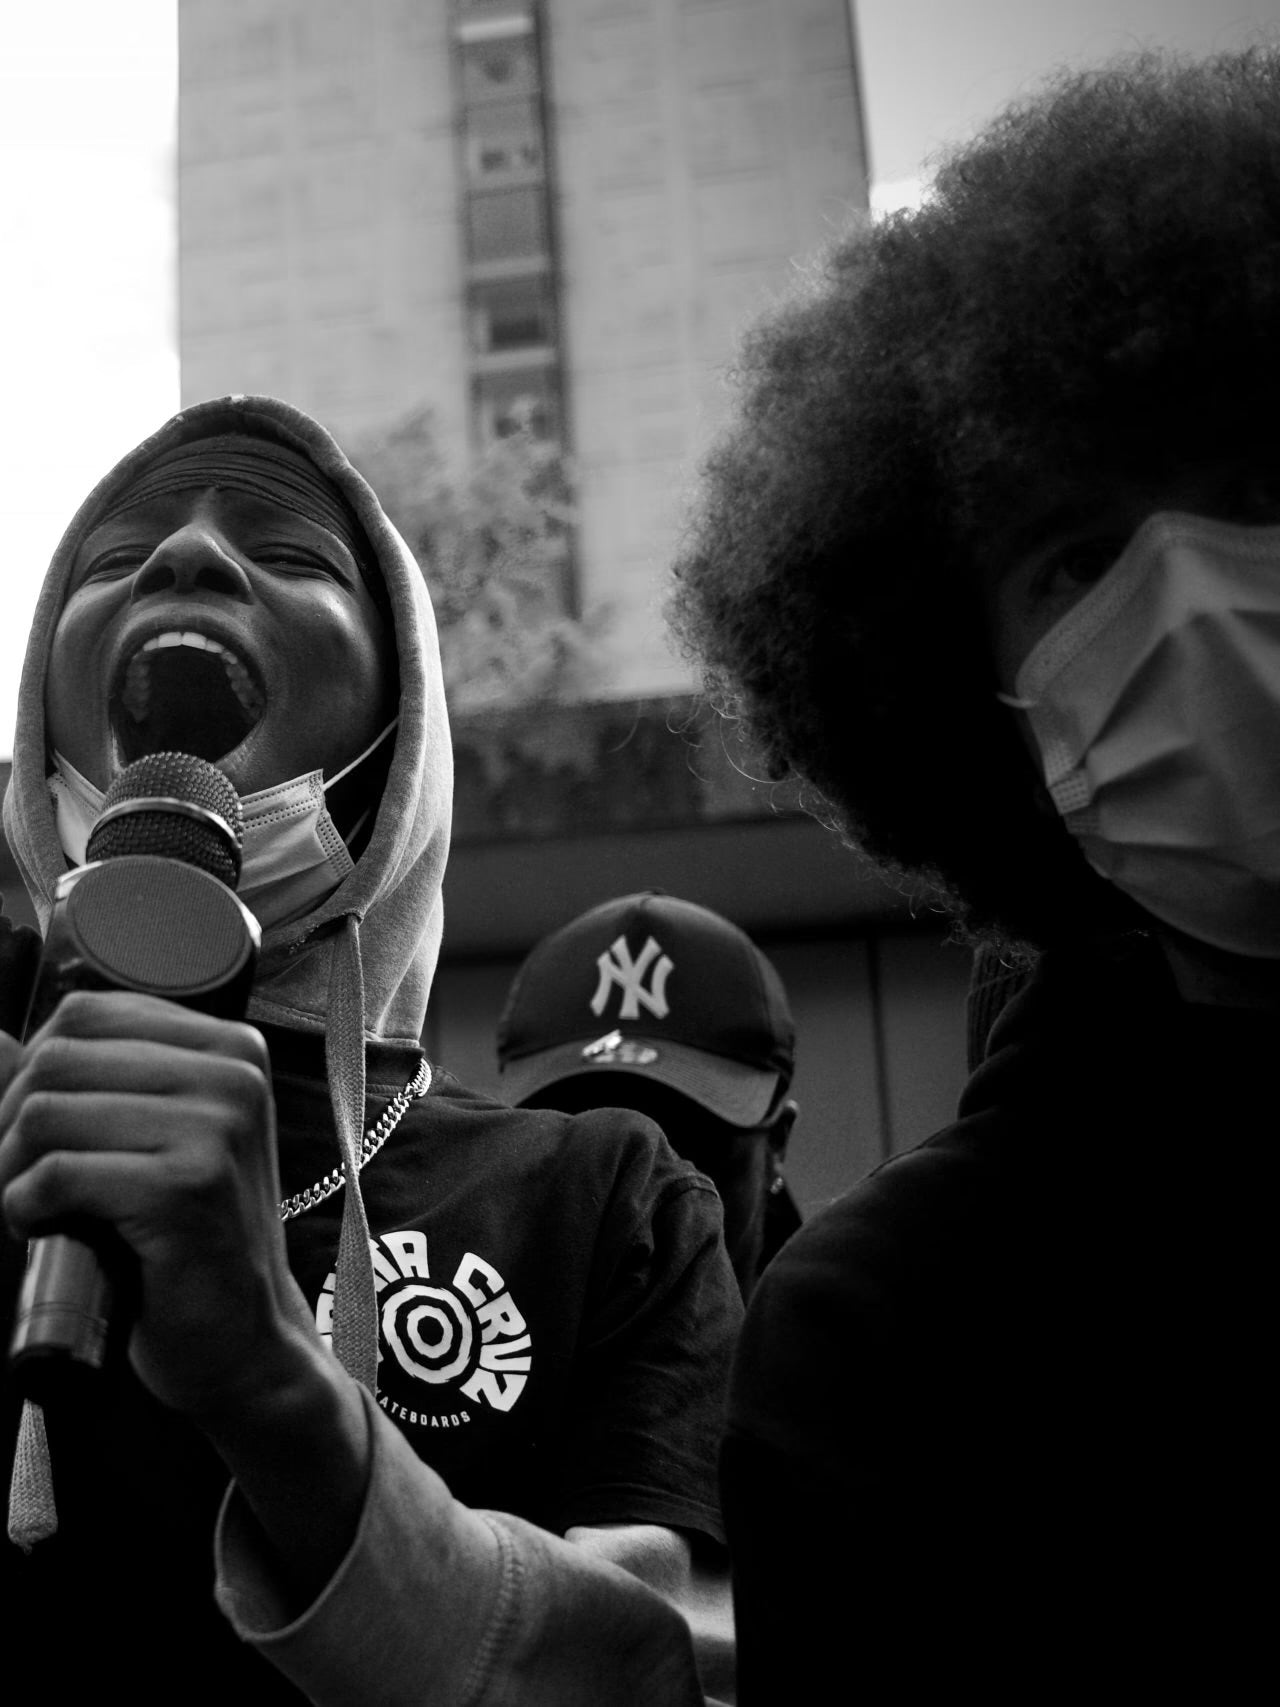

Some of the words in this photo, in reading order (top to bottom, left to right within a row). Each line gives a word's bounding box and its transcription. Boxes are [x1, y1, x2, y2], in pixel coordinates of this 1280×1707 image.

[590, 934, 674, 1020] NY
[452, 1252, 532, 1412] CRUZ
[375, 1387, 472, 1428] ATEBOARDS
